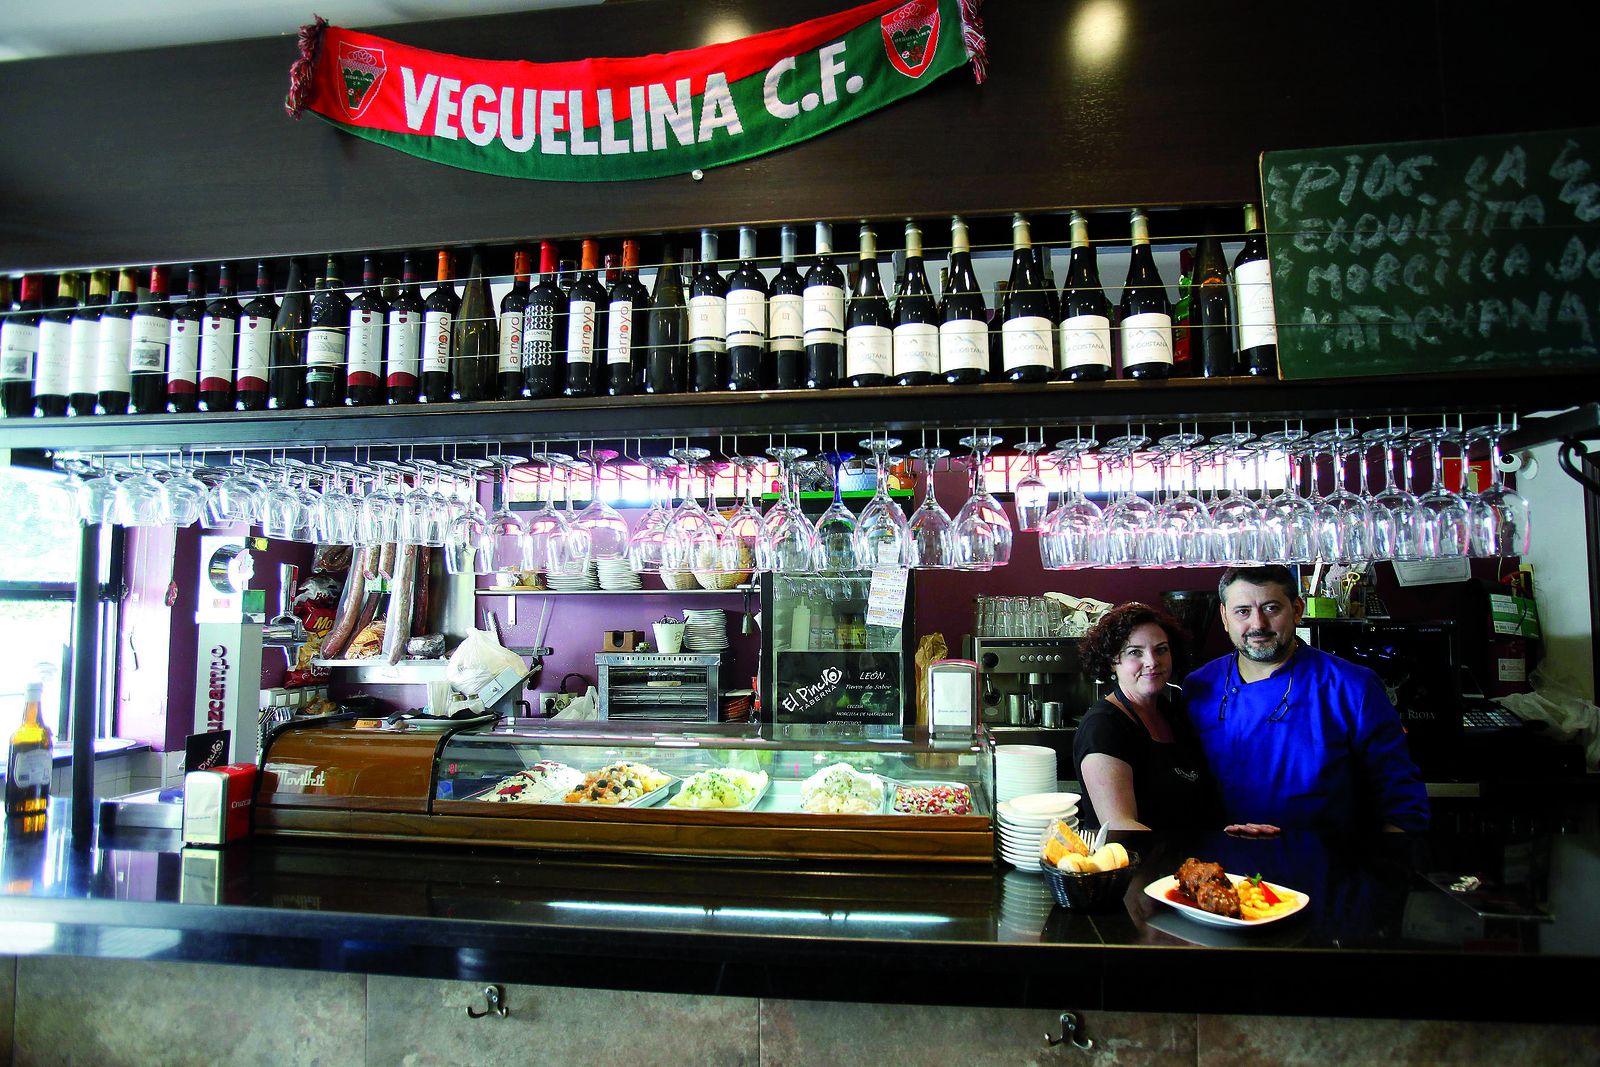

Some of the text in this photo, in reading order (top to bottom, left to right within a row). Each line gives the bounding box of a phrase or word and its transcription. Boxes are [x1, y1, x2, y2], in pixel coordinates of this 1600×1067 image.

[400, 40, 864, 157] VEGUELLINA C.F.
[1464, 144, 1528, 194] LA
[437, 316, 451, 364] arroyo
[509, 317, 522, 364] arroyo
[581, 305, 595, 355] arroyo
[618, 305, 632, 355] arroyo
[207, 645, 230, 733] uzcampo
[782, 692, 800, 712] El
[798, 685, 837, 712] TABERNA
